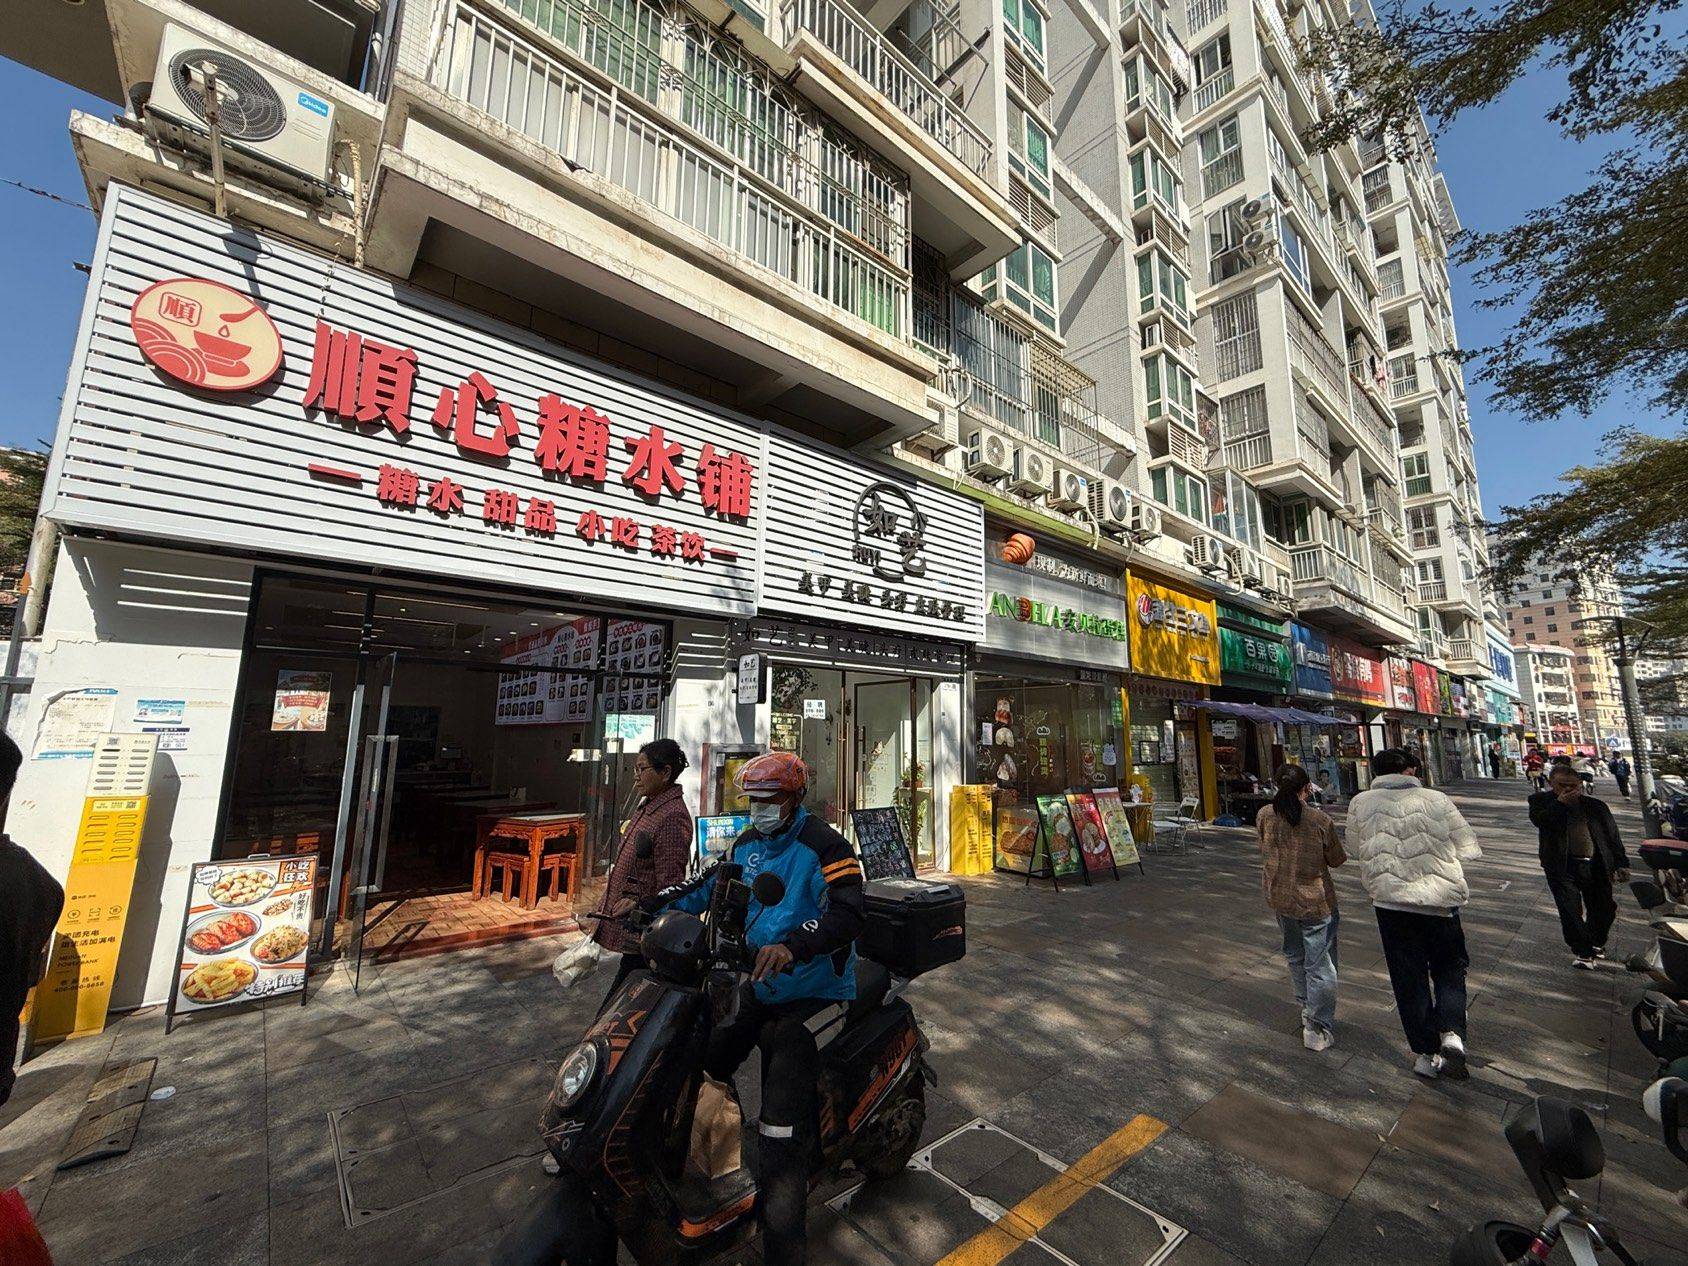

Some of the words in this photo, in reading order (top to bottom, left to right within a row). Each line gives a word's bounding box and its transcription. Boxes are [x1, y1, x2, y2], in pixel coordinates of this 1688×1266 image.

[163, 295, 197, 323] 順
[302, 320, 753, 518] 順心糖水铺
[376, 463, 464, 512] 糖水
[482, 488, 557, 533] 甜品
[576, 510, 640, 548] 小吃
[650, 524, 706, 561] 茶饮
[798, 571, 832, 597] 美甲
[1244, 638, 1279, 663] 百果园
[285, 861, 310, 872] 小吃
